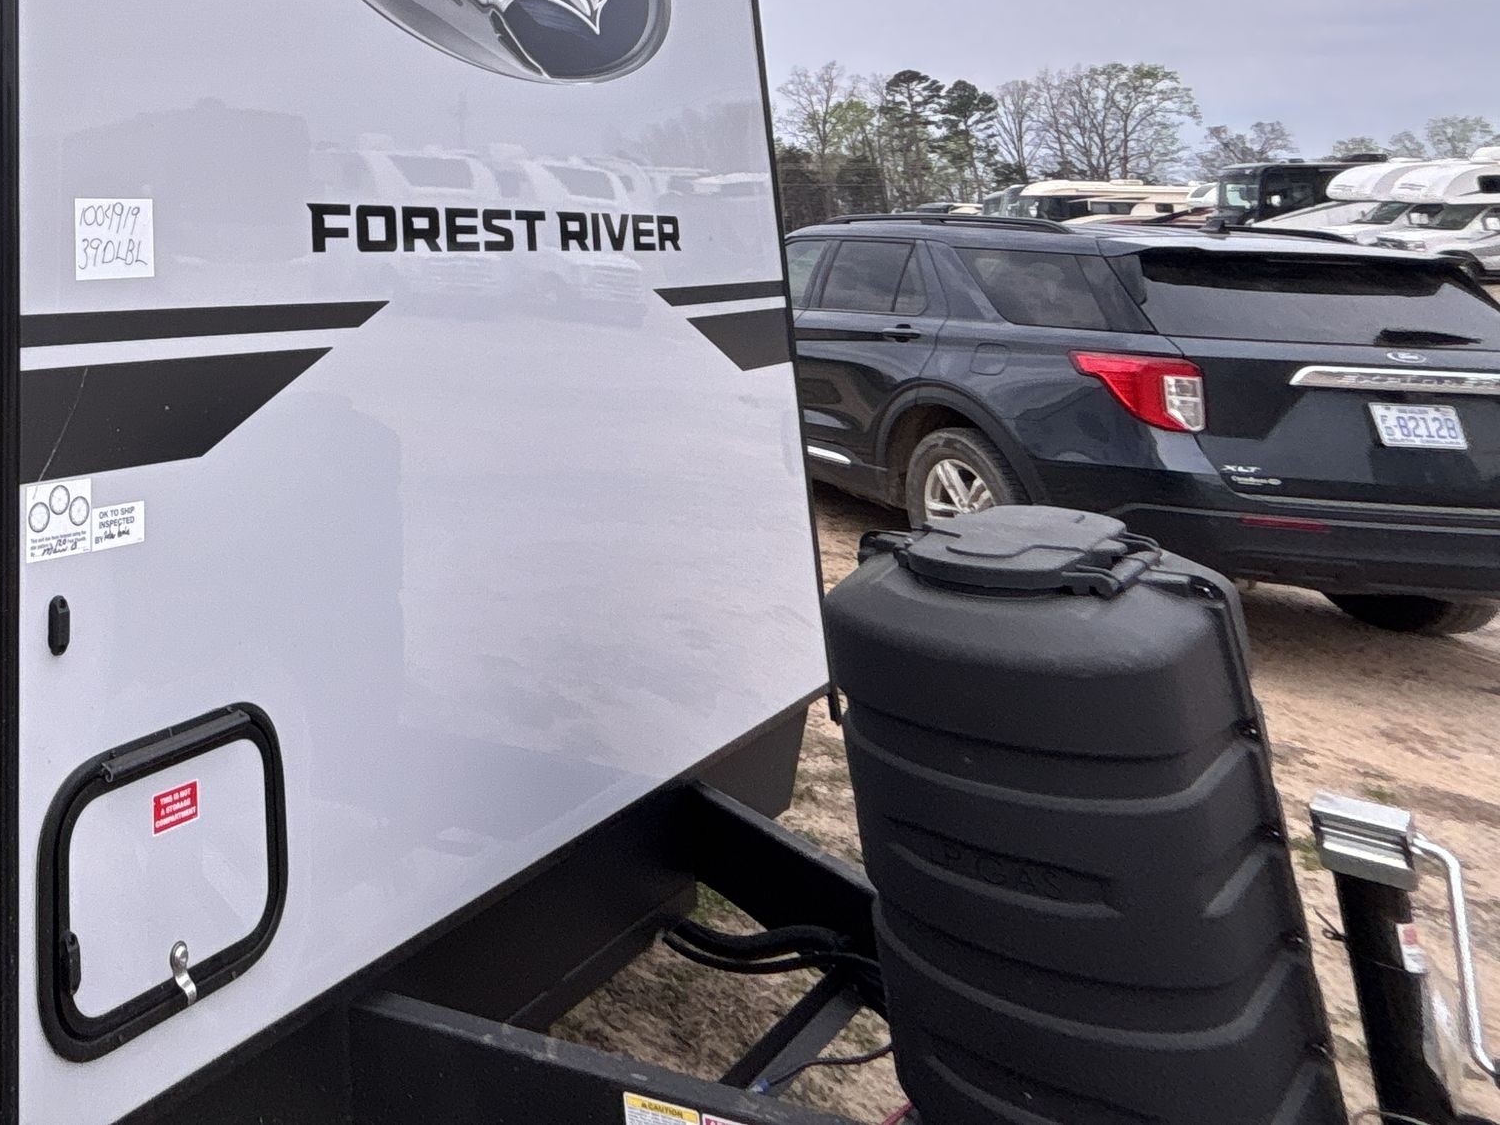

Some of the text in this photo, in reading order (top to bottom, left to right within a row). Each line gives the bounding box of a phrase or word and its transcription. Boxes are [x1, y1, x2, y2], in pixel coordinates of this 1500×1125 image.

[306, 202, 682, 253] FOREST RIVER
[1220, 465, 1262, 473] XLT
[98, 506, 135, 520] OK TO SHIP
[98, 516, 135, 529] INSPECTED
[94, 535, 103, 544] BY
[160, 788, 192, 806] THIS IS NOT
[155, 806, 196, 828] COMPARTMENT
[647, 1102, 683, 1119] CAUTION
